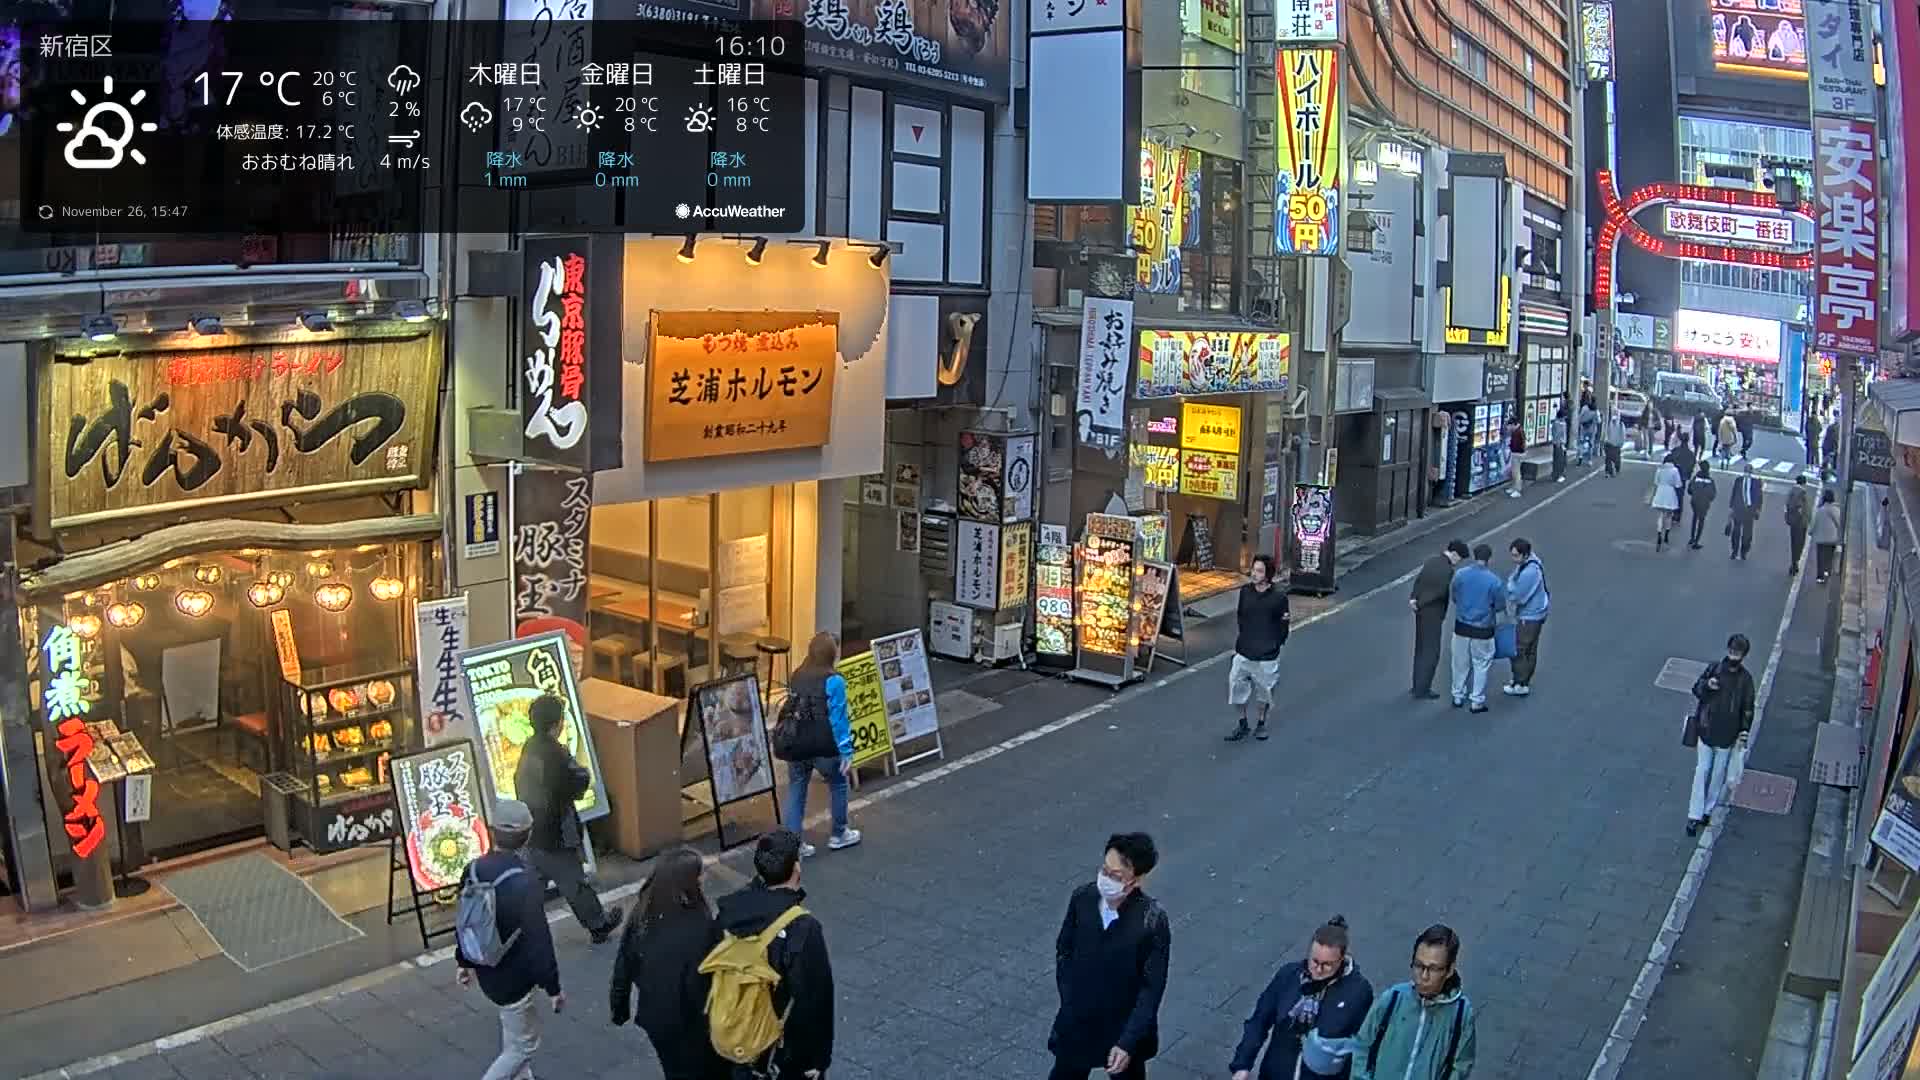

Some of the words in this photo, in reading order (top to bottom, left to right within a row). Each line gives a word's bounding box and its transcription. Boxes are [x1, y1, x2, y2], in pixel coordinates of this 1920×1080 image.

[1296, 54, 1320, 189] ハイボール
[1289, 194, 1326, 251] 50円
[1669, 210, 1789, 241] 歌舞伎町一番街
[1819, 126, 1876, 329] 安楽亭
[560, 253, 586, 400] 東京豚骨
[1096, 309, 1126, 416] お好み焼き
[1817, 332, 1837, 347] 2F
[65, 378, 407, 492] ばんから
[668, 366, 823, 406] 芝浦ホルモン
[515, 521, 566, 618] 豚玉
[561, 476, 592, 602] スタミナ
[1038, 598, 1070, 615] 980
